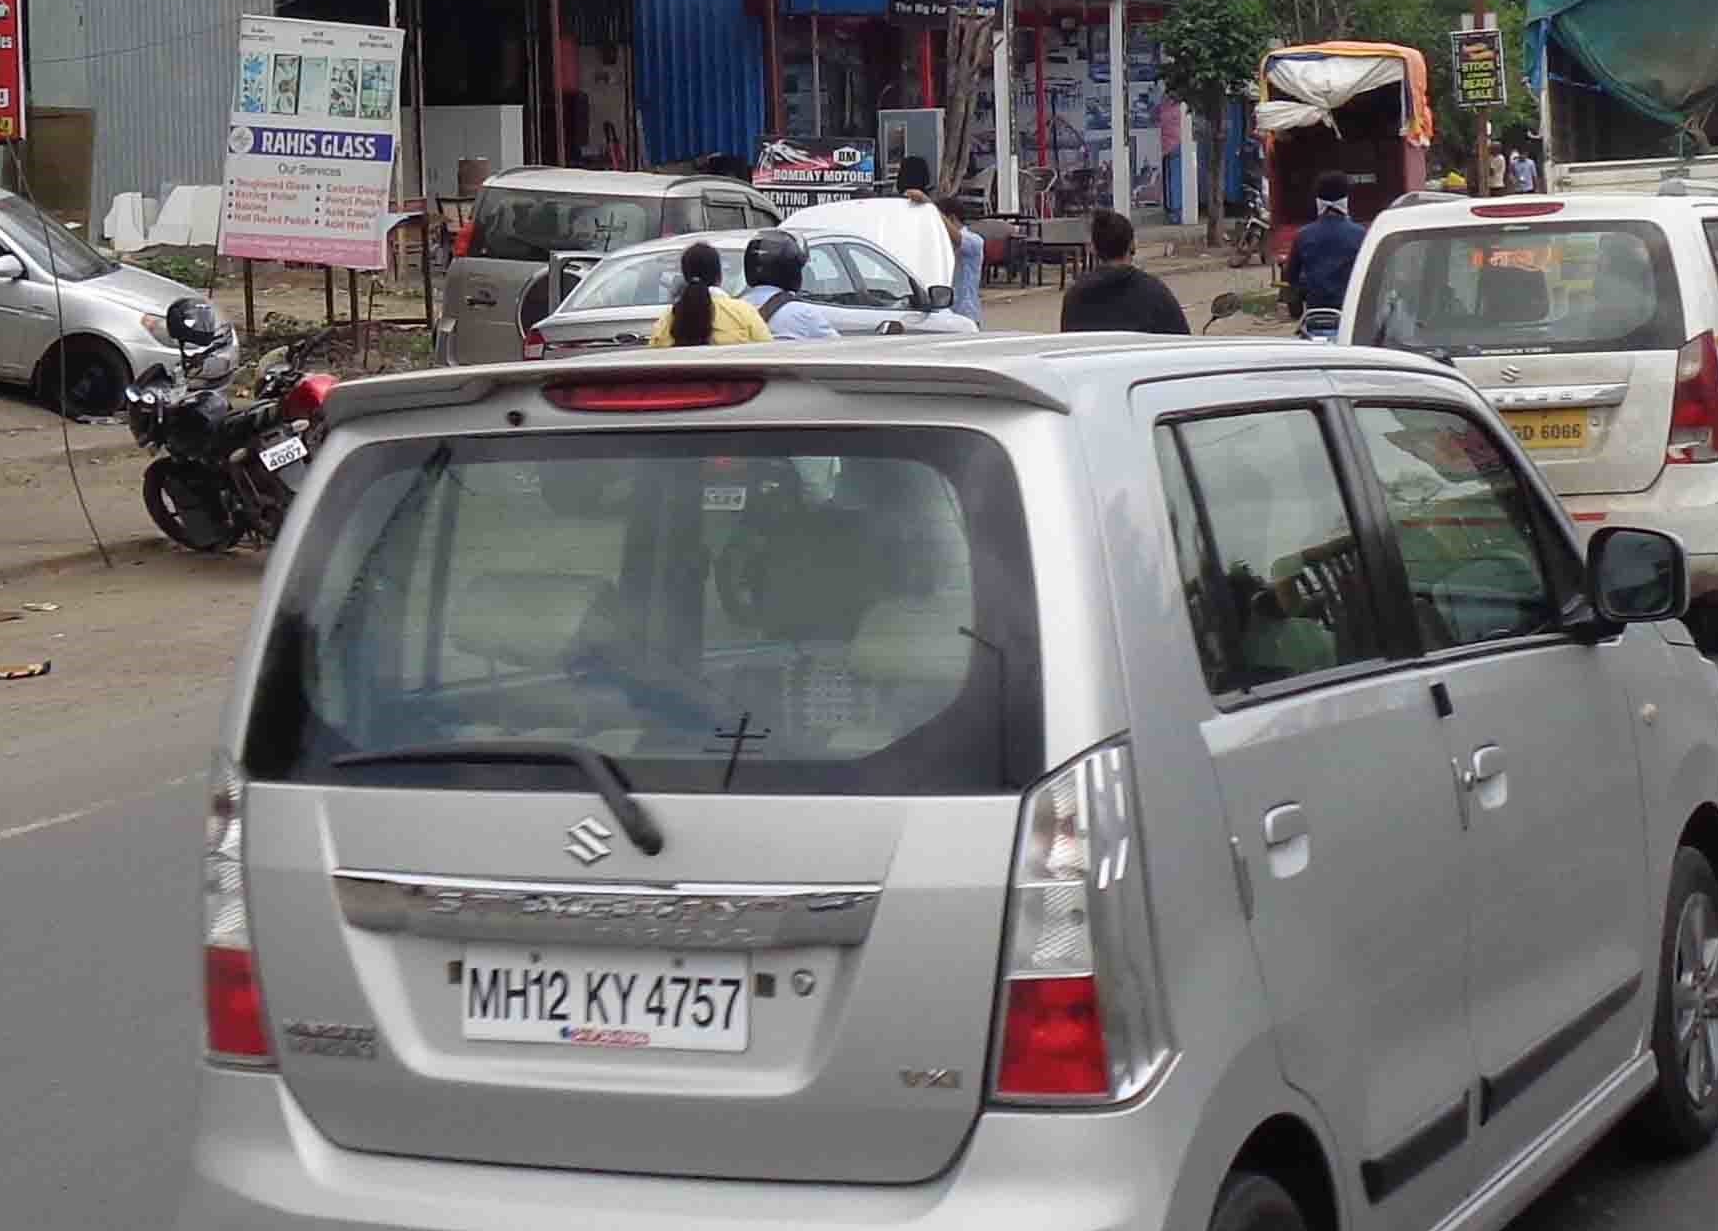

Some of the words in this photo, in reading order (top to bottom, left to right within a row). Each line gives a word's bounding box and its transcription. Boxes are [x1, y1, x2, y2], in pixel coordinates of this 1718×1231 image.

[261, 130, 317, 155] RAHIS
[320, 134, 376, 159] GLASS
[277, 162, 298, 176] Our
[299, 164, 343, 178] Services
[773, 169, 822, 181] BOMBAY
[823, 170, 873, 183] MOTORS
[469, 968, 571, 1021] MH12
[586, 971, 638, 1025] KY
[645, 974, 742, 1030] 4757
